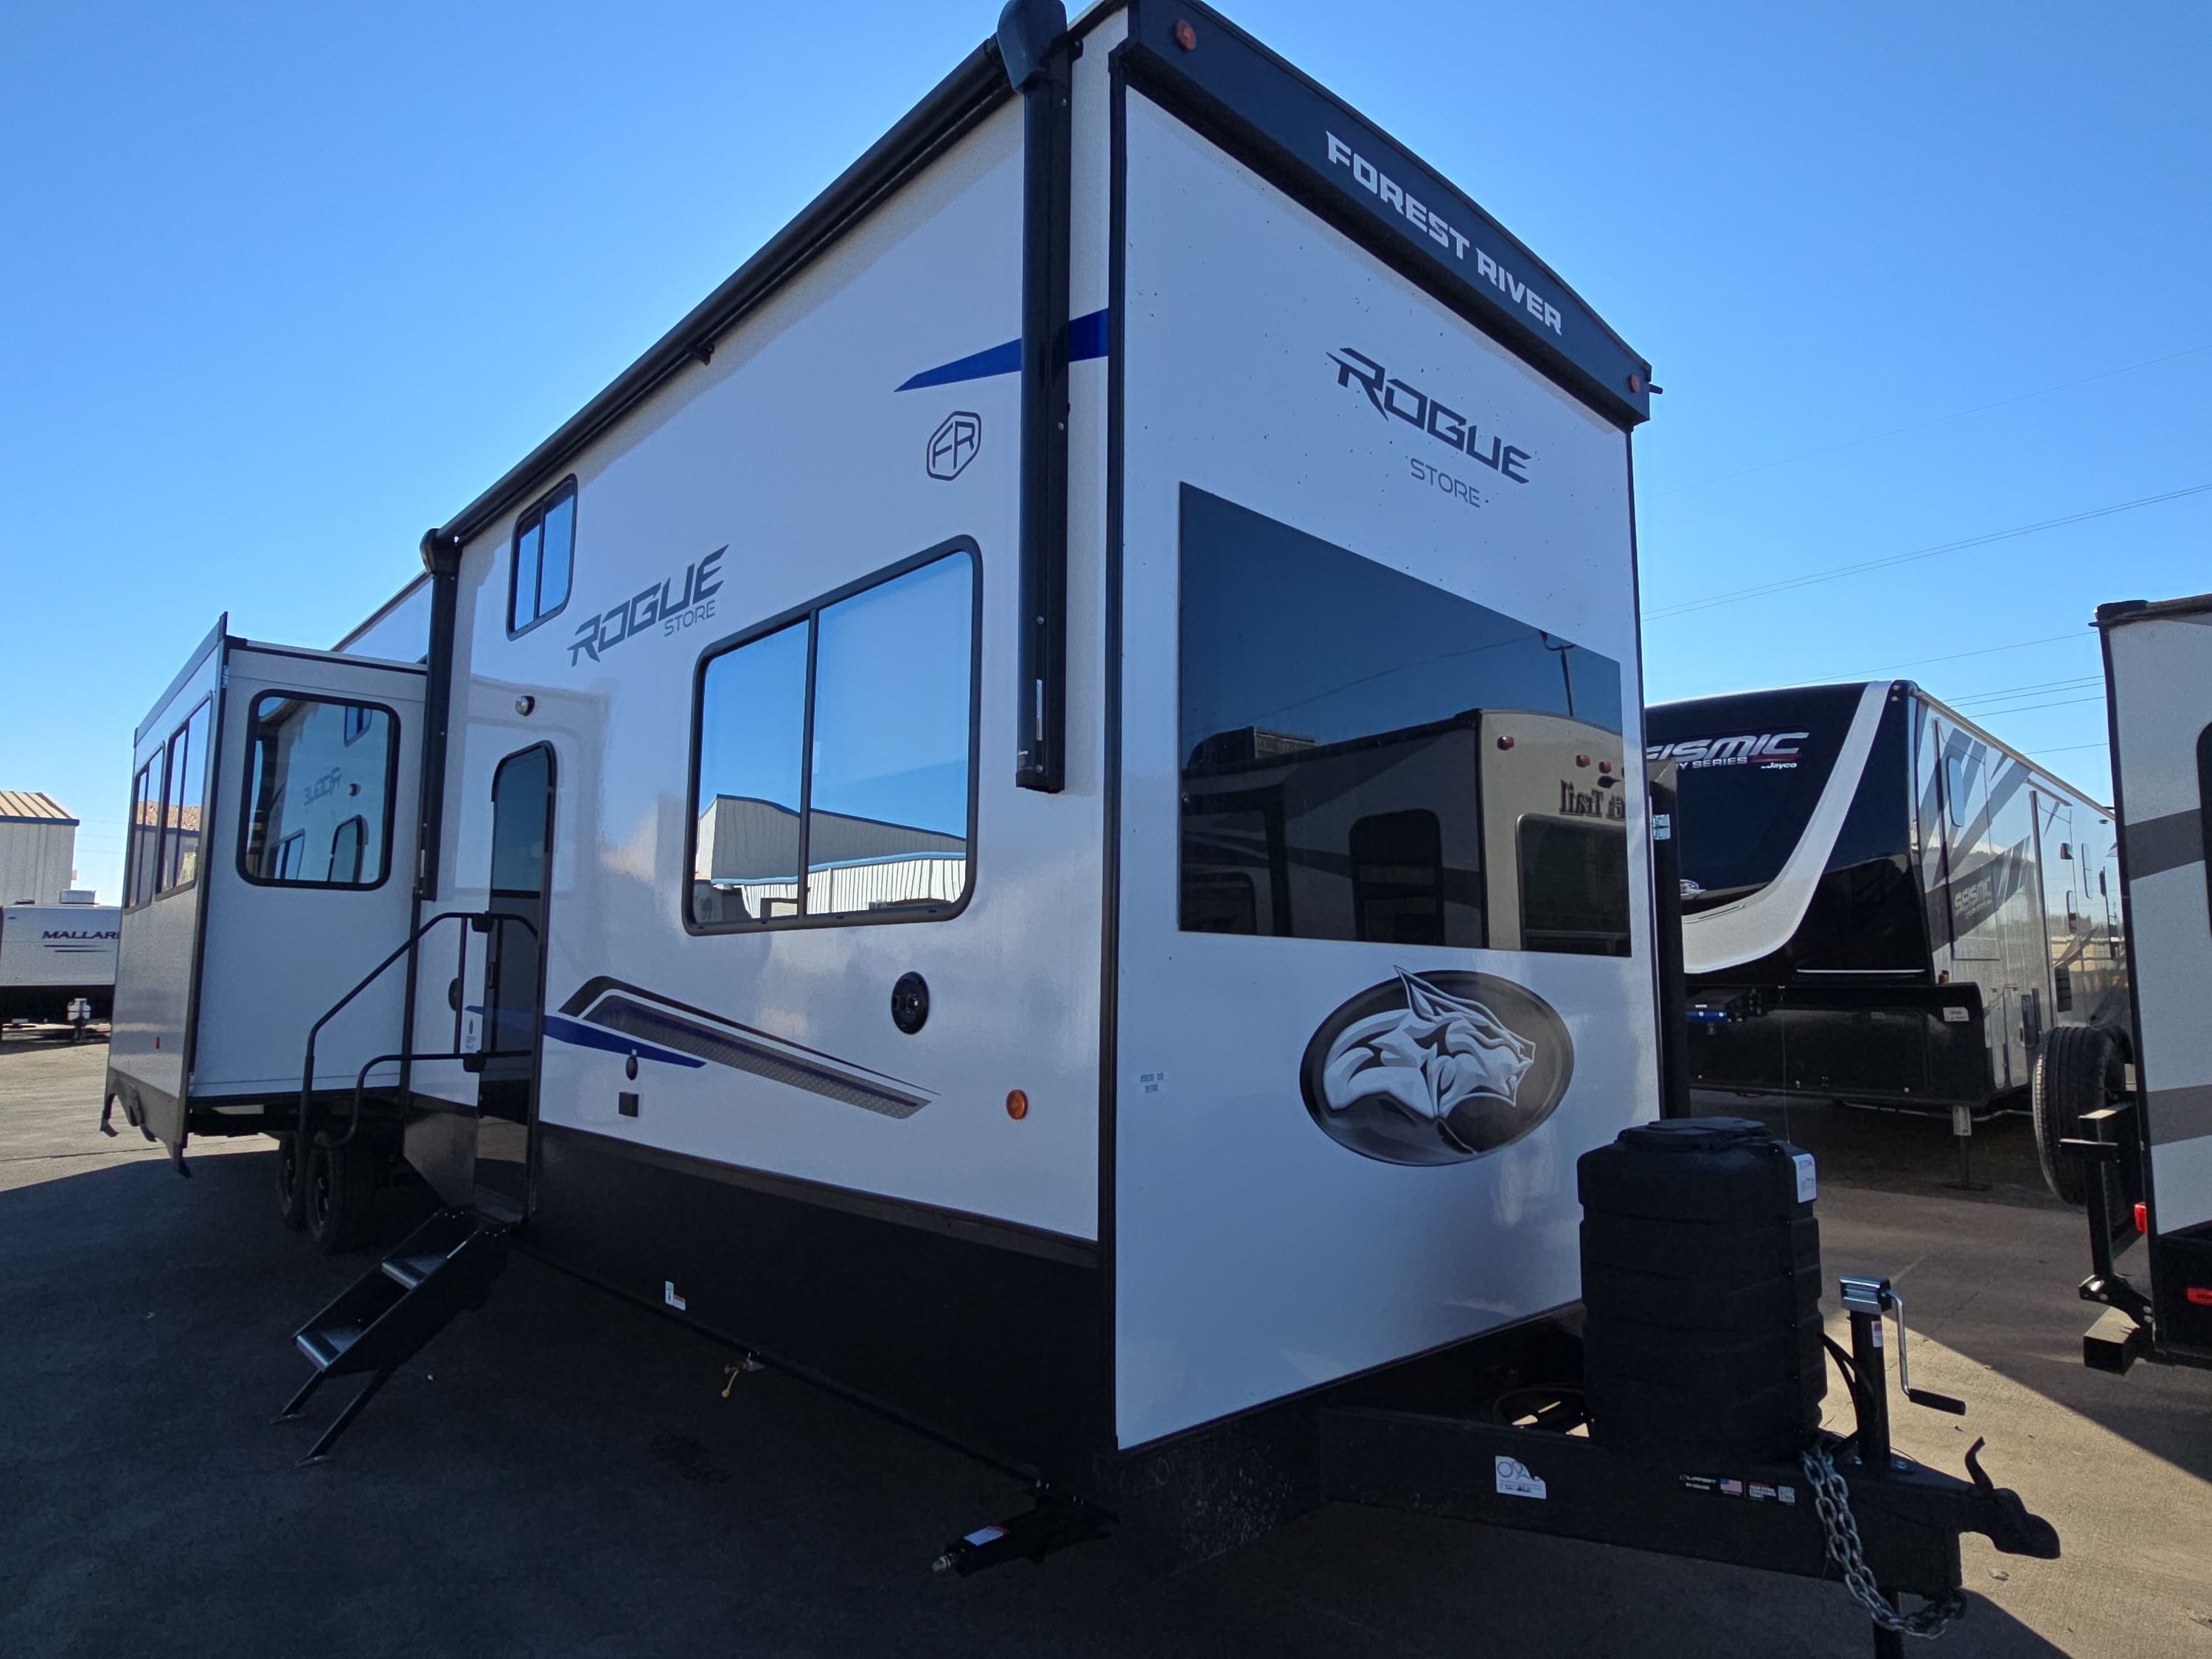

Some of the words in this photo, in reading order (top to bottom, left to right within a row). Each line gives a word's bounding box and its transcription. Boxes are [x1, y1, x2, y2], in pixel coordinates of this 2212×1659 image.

[1326, 130, 1470, 260] FOREST
[1475, 247, 1562, 335] RIVER
[1326, 347, 1531, 484] ROGUE
[1410, 457, 1481, 508] STORE
[566, 543, 730, 667] ROGUE
[664, 599, 716, 637] STORE
[1646, 732, 1810, 762] EISMIC
[1692, 757, 1748, 769] SERIES
[1767, 762, 1798, 770] Jayco
[41, 931, 120, 940] MALLAR
